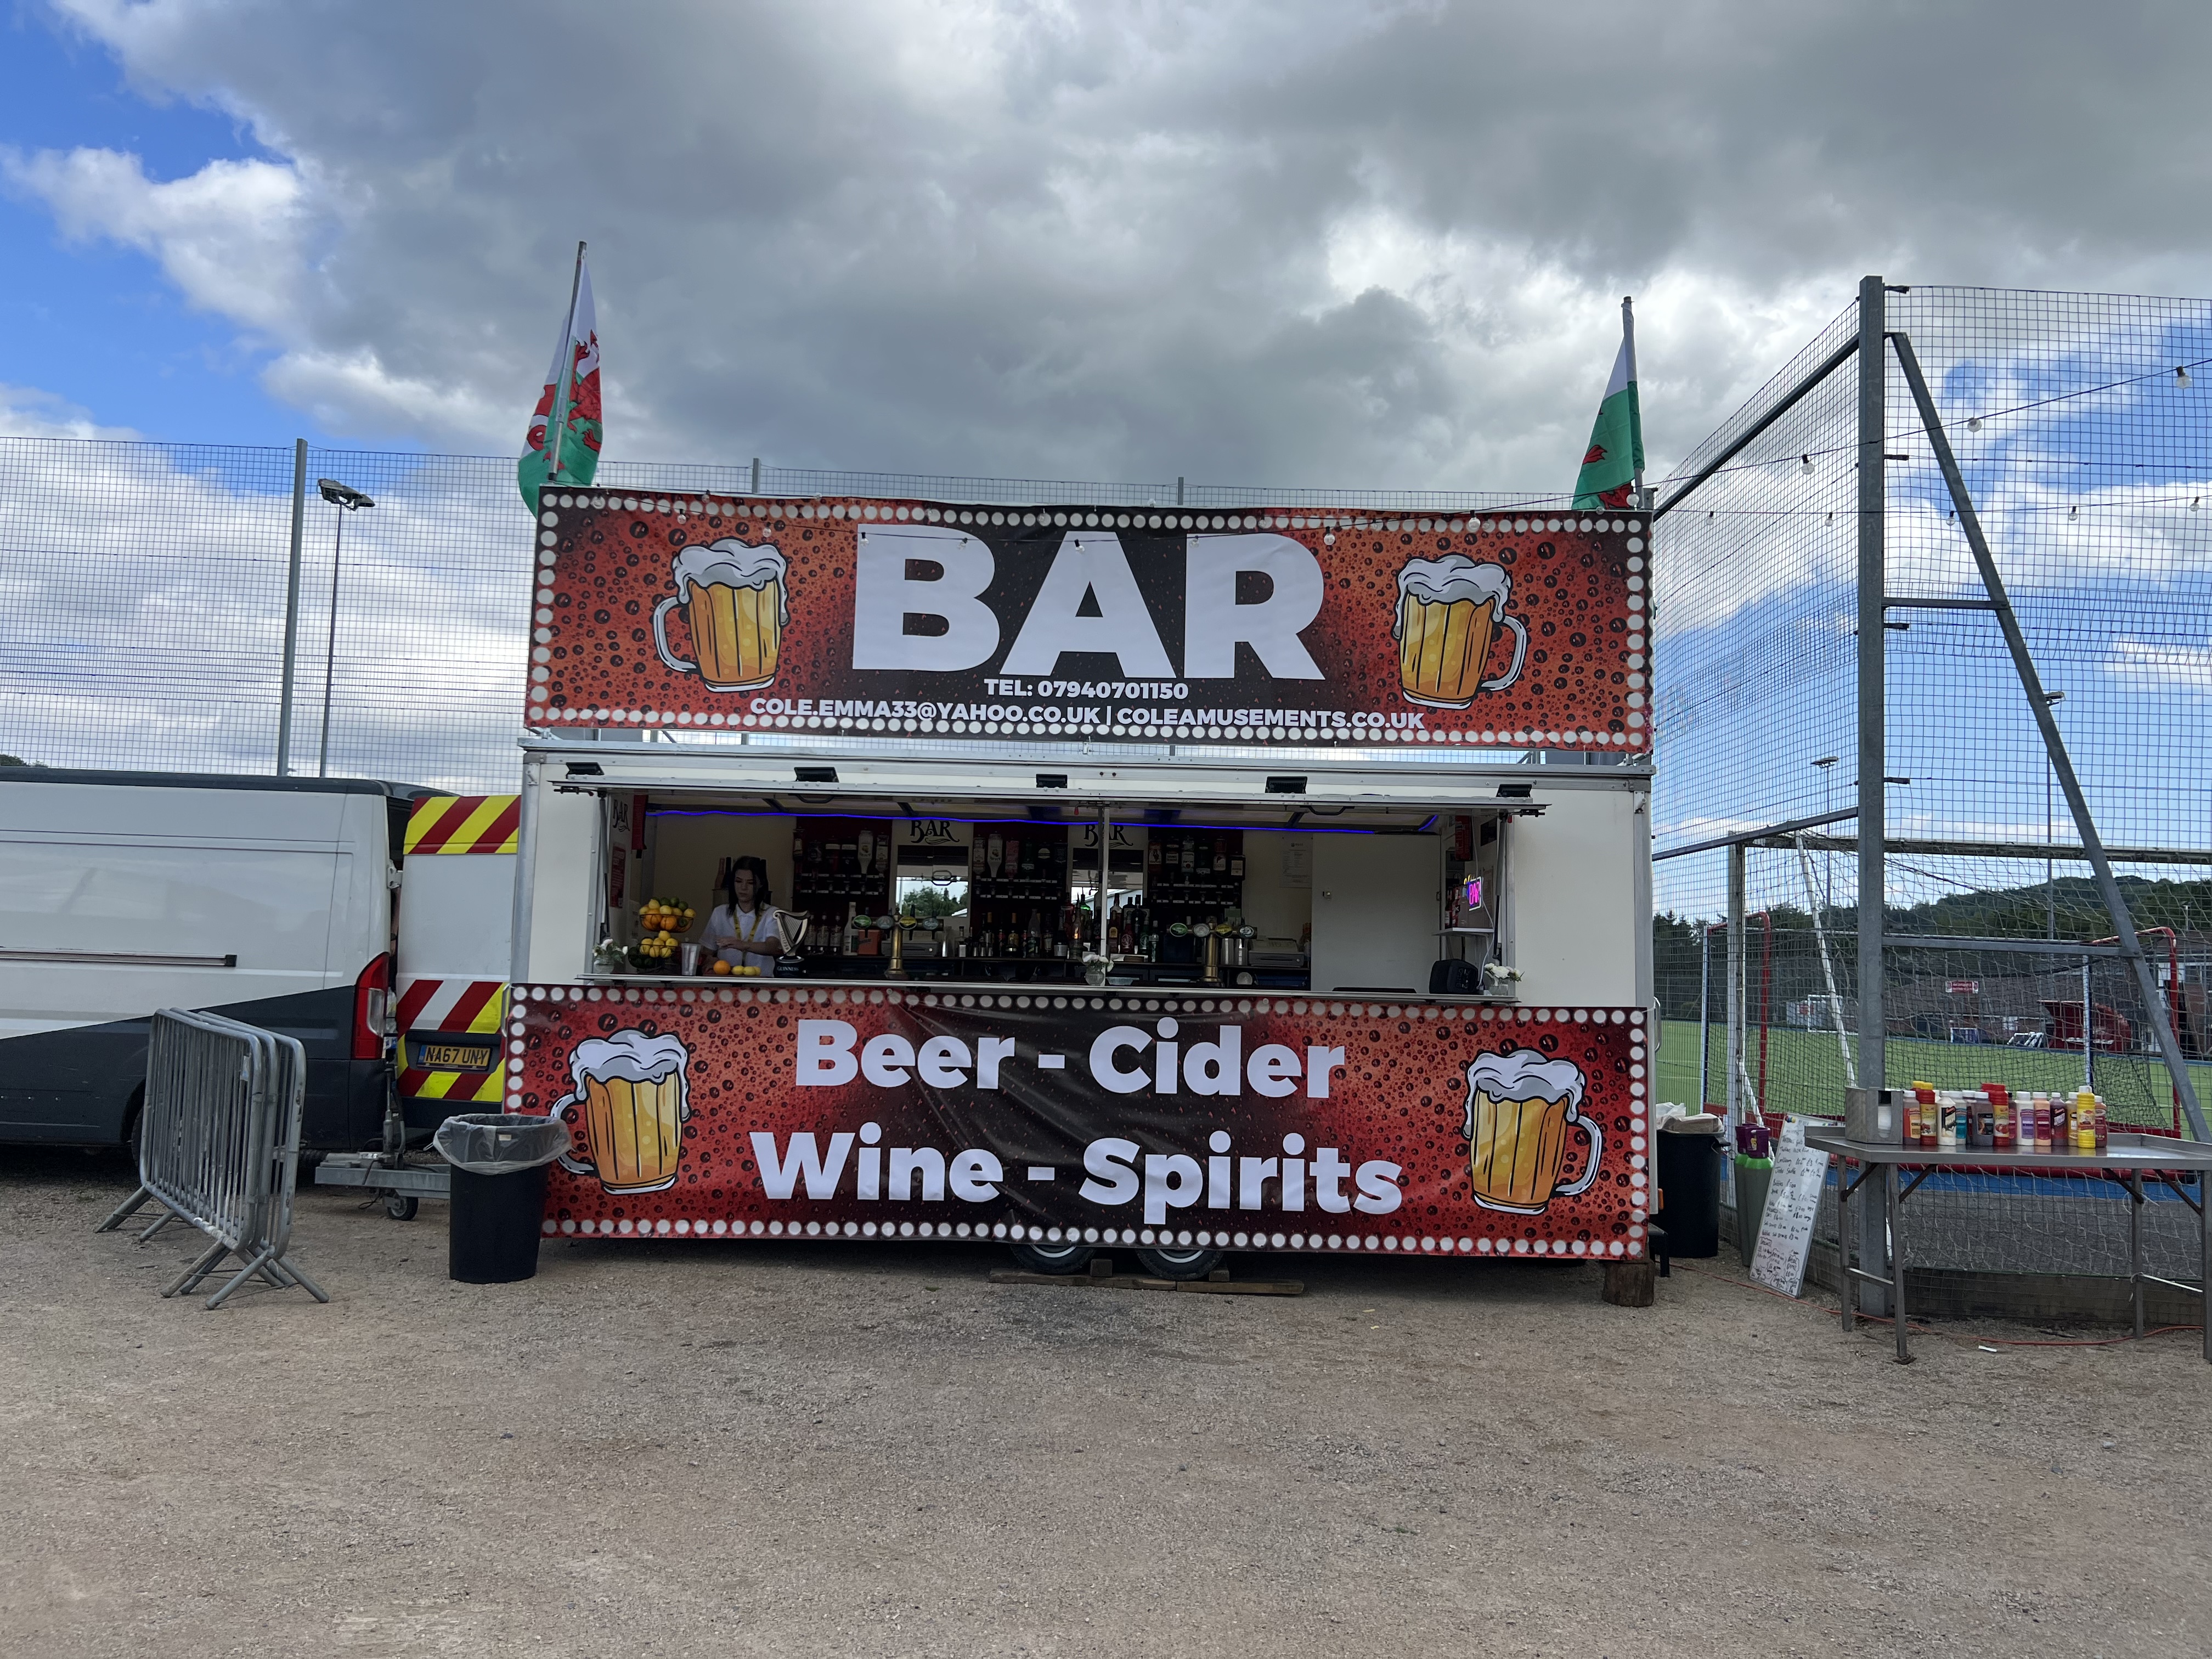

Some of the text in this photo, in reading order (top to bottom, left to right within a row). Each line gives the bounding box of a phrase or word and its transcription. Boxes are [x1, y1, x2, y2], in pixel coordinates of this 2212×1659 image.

[853, 523, 1326, 680] BAR
[984, 678, 1189, 700] TEL: 07940701150
[750, 697, 1101, 724] COLE.EMMA33@YAHOO.CO.UK
[1117, 708, 1426, 730] COLEAMUSEMENTS.CO.UK
[613, 798, 630, 831] BAR
[910, 820, 960, 844] BAR
[425, 1046, 488, 1065] NA67 UNY
[795, 1019, 1015, 1090] Beer
[1089, 1016, 1345, 1098] Cider
[749, 1121, 1004, 1203] Wine
[1079, 1130, 1403, 1225] Spirits
